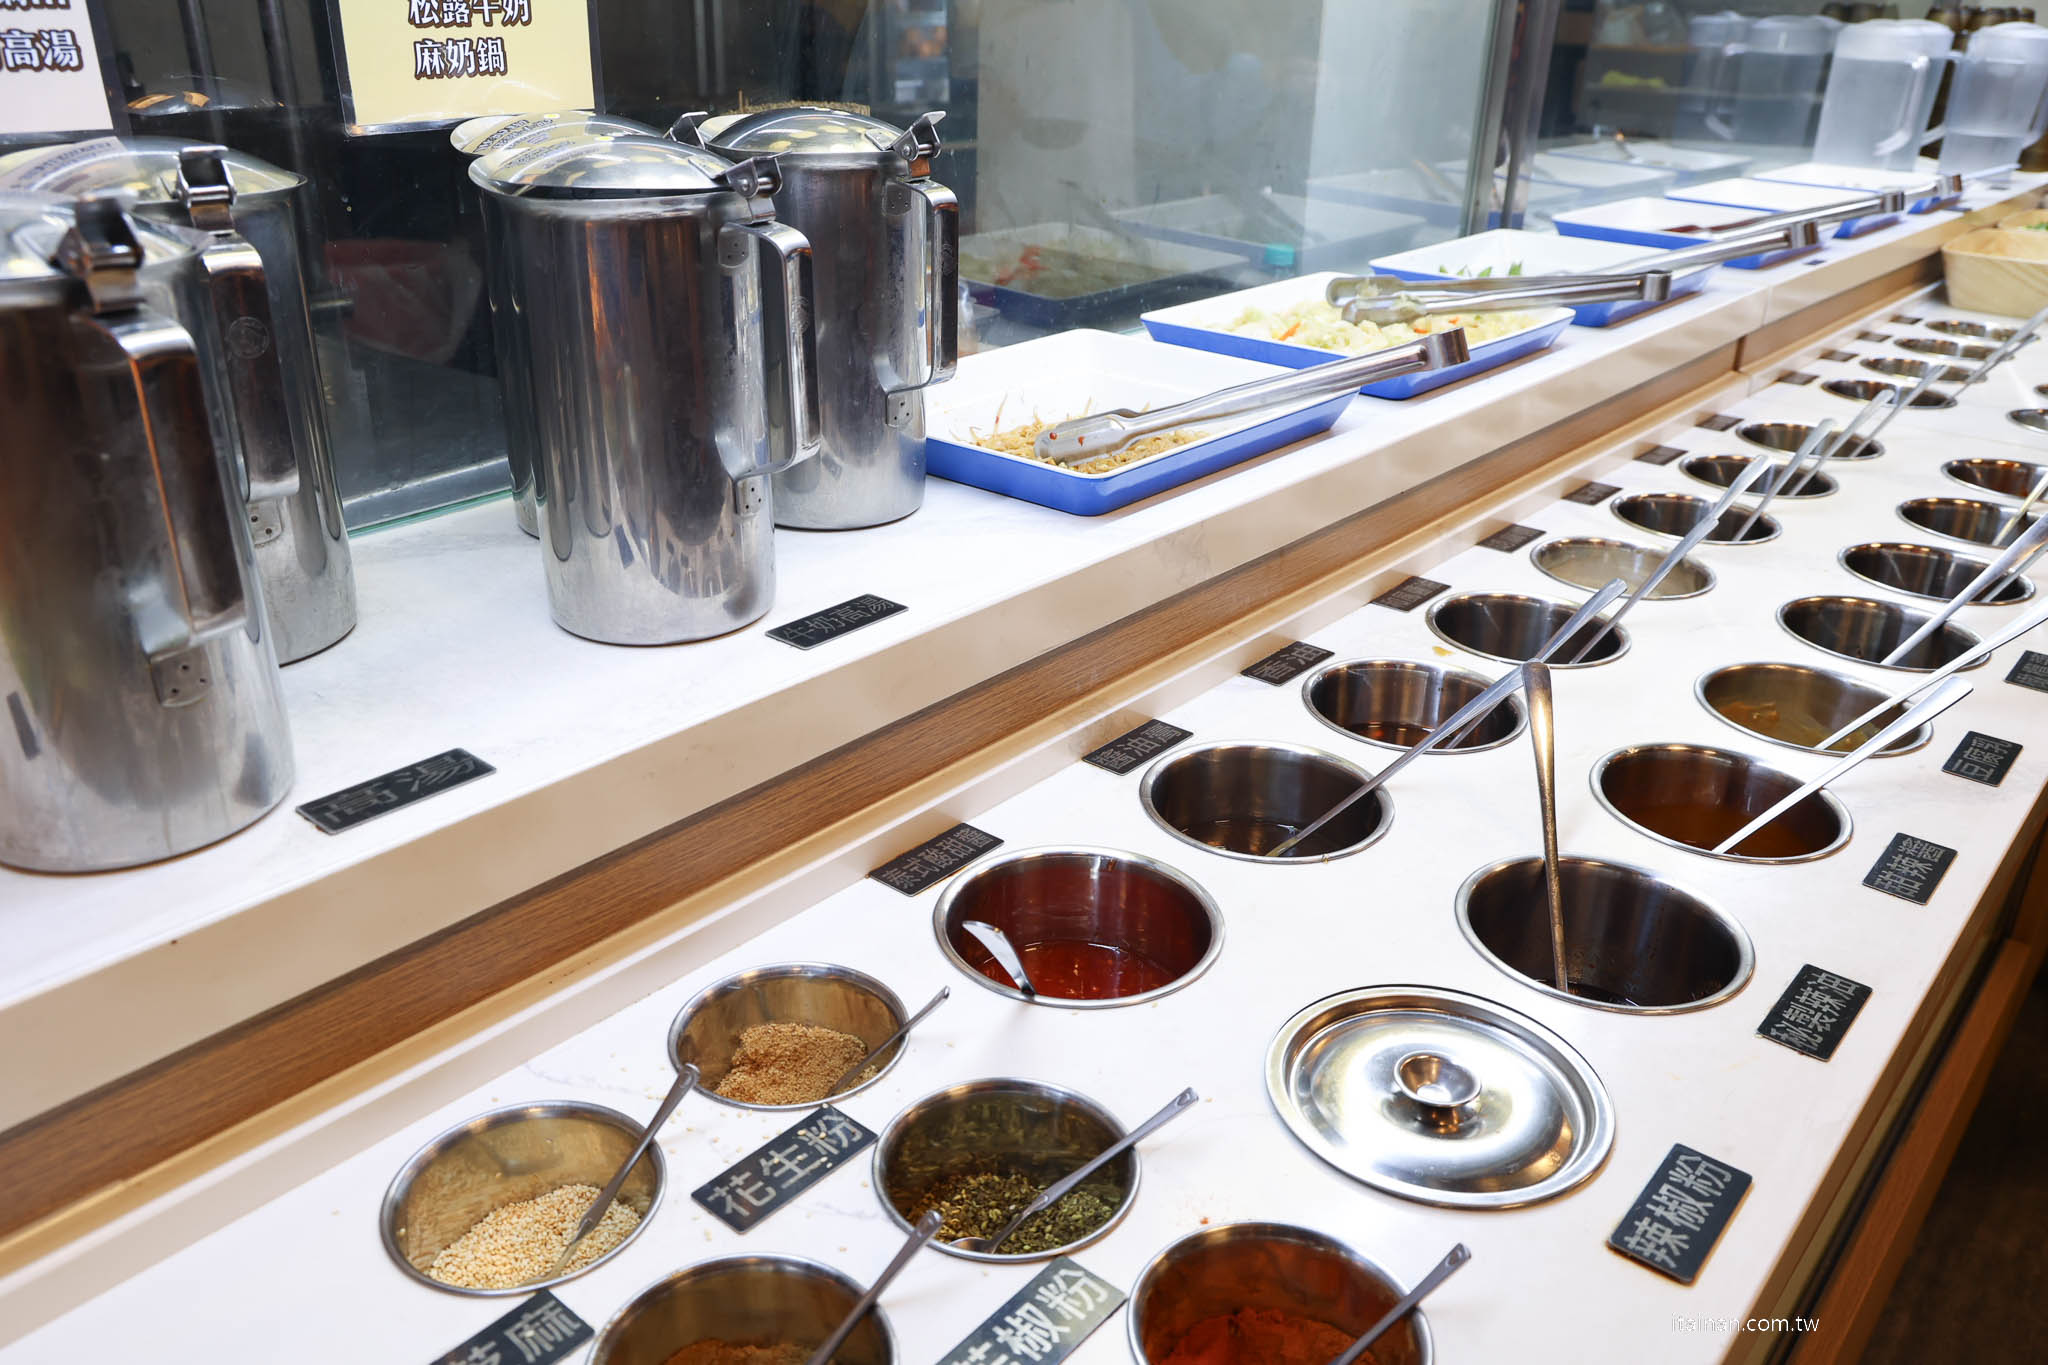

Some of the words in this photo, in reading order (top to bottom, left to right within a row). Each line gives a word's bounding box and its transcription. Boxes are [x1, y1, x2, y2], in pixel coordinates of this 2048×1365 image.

[413, 37, 508, 80] 麻奶鍋
[781, 596, 894, 640] 牛奶高湯
[311, 755, 475, 824] 高湯
[1952, 736, 2013, 781] 豆腐乳
[881, 828, 994, 889] 泰式酸甜醬
[1873, 837, 1946, 897] 甜辣醬
[1770, 972, 1860, 1051] 秘製辣油
[707, 1114, 863, 1217] 花生粉
[1624, 1155, 1732, 1268] 辣椒粉
[951, 1268, 1108, 1365] 椒粉
